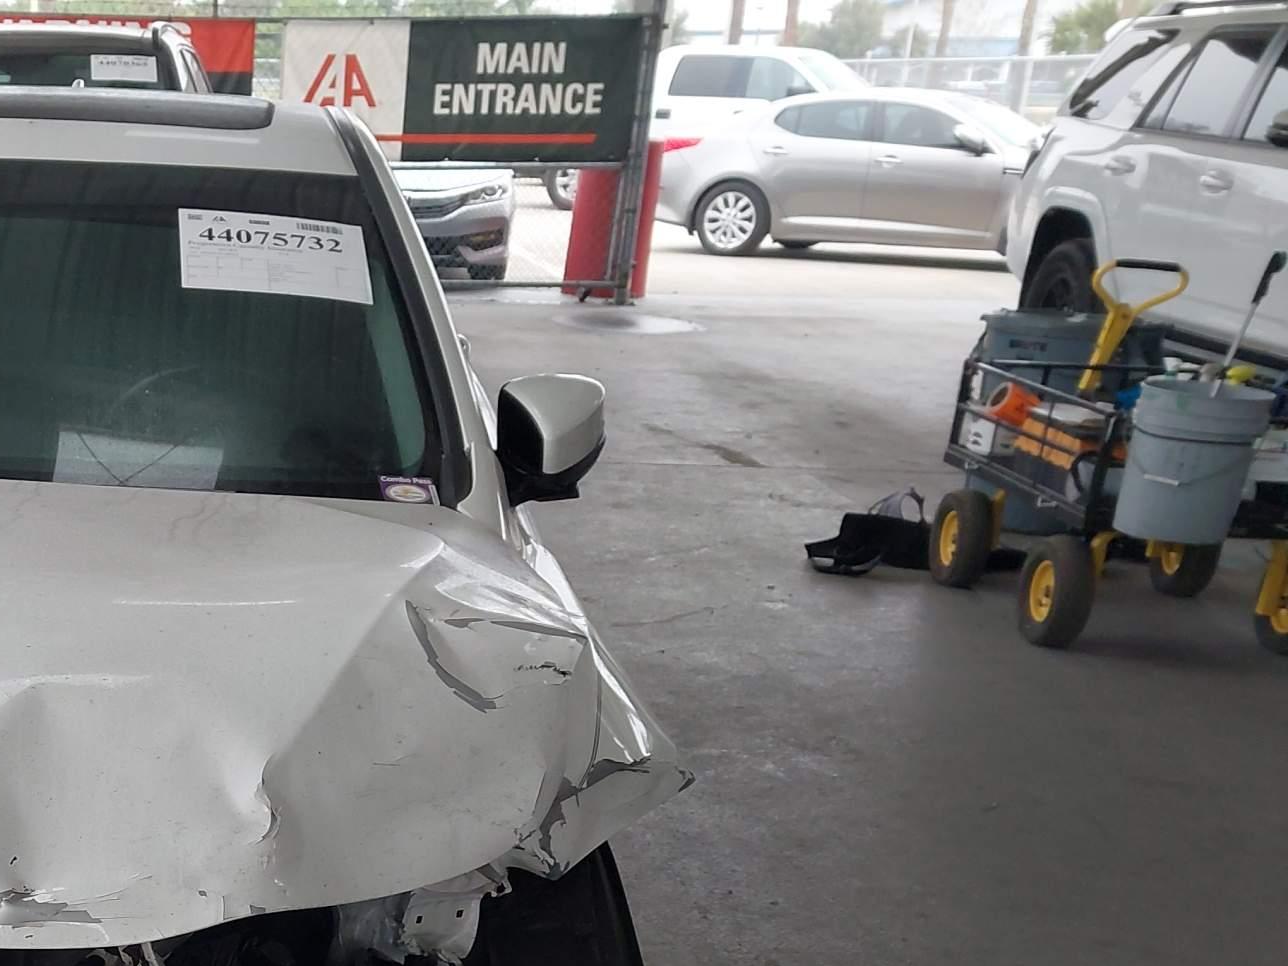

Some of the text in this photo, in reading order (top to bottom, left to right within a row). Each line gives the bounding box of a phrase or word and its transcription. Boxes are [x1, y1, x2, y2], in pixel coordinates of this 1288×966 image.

[475, 41, 567, 75] MAIN
[432, 82, 605, 115] ENTRANCE
[199, 226, 344, 254] 44075732
